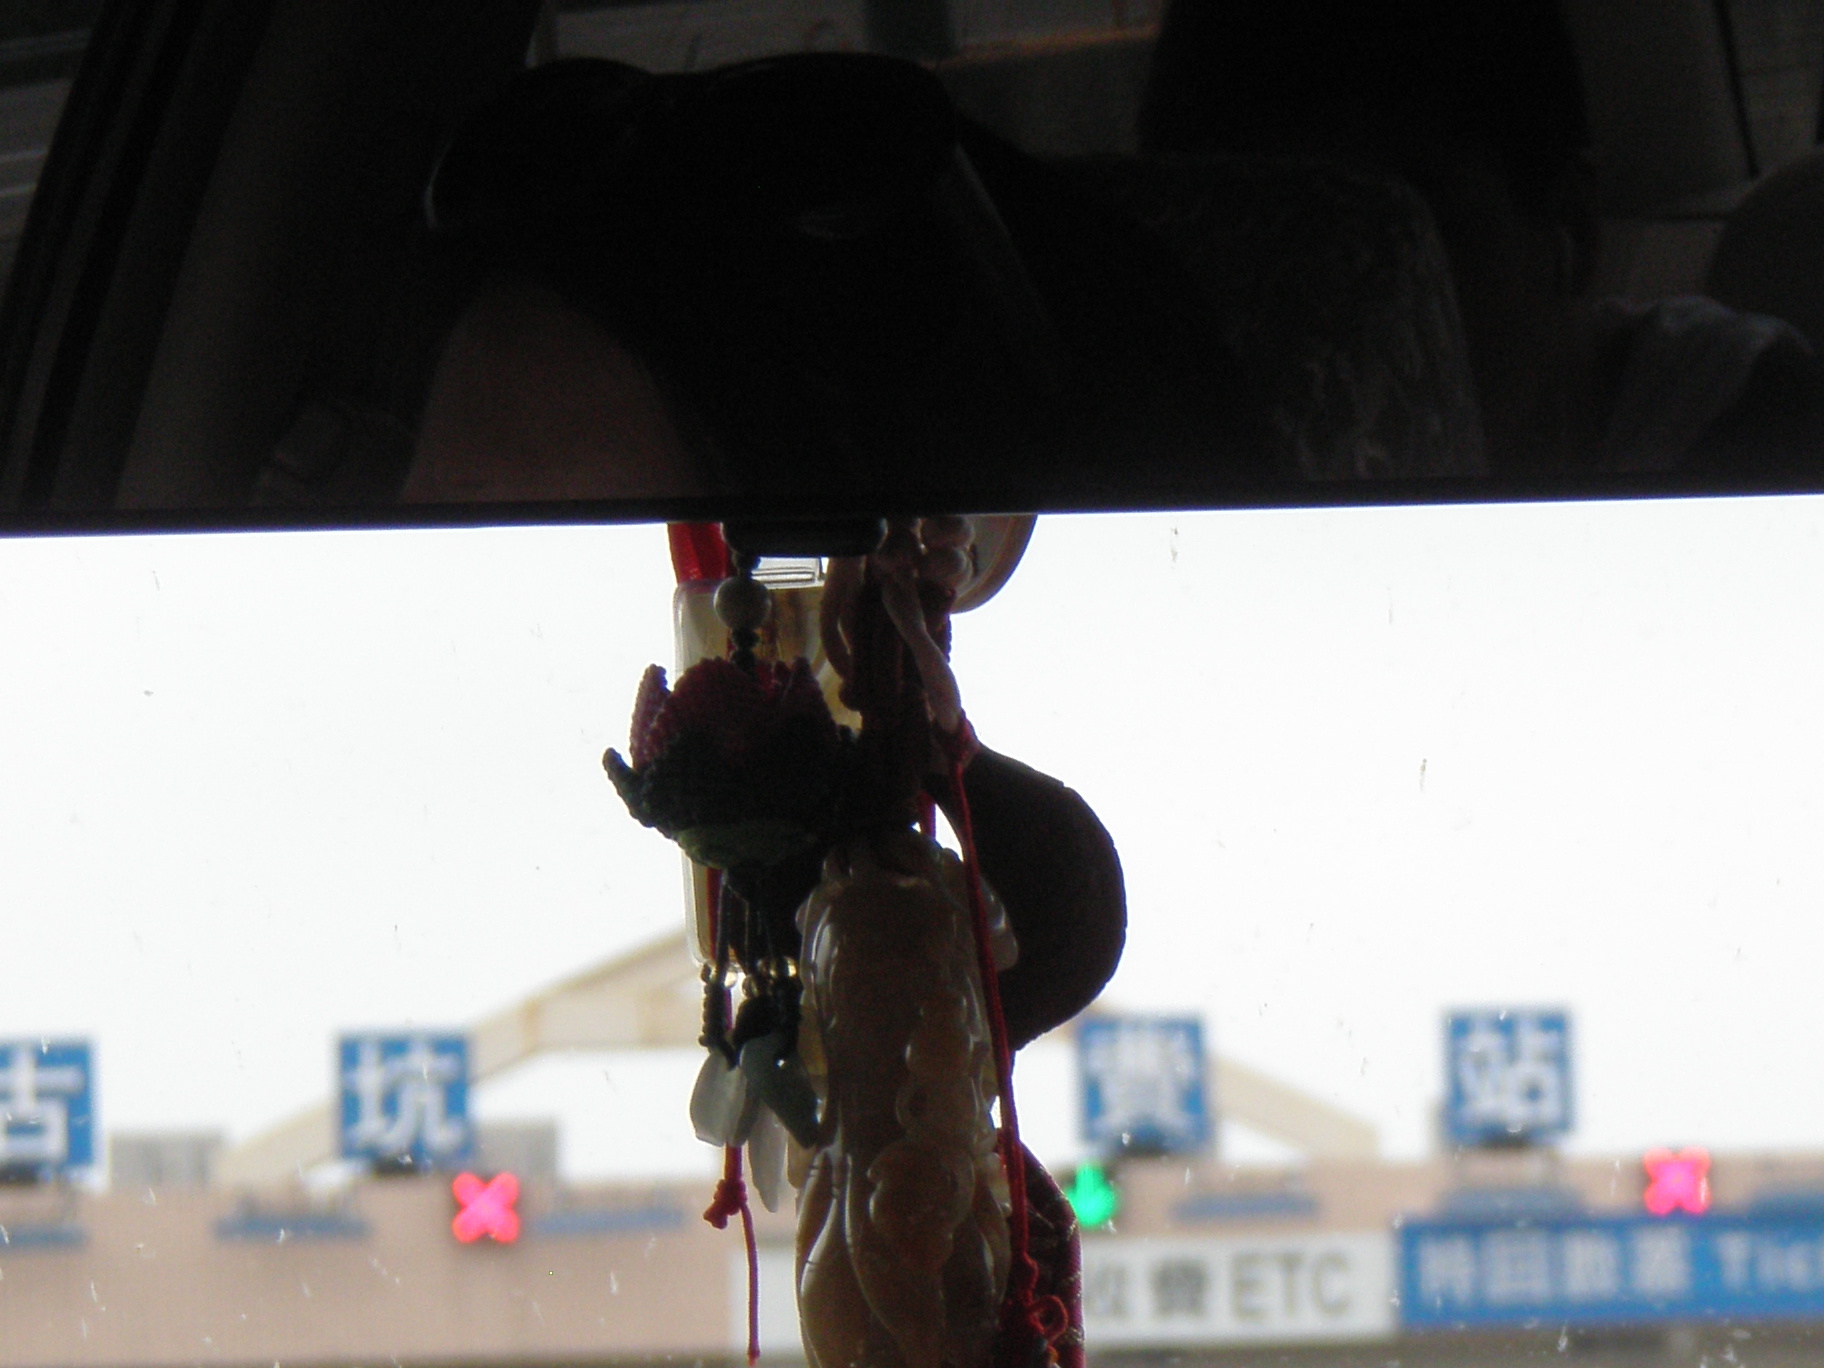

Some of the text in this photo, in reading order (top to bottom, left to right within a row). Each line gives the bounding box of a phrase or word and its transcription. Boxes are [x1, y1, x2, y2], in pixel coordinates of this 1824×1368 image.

[0, 1043, 85, 1164] 古
[344, 1040, 465, 1152] 坑
[1457, 1020, 1565, 1129] 站
[1230, 1249, 1351, 1321] ETC
